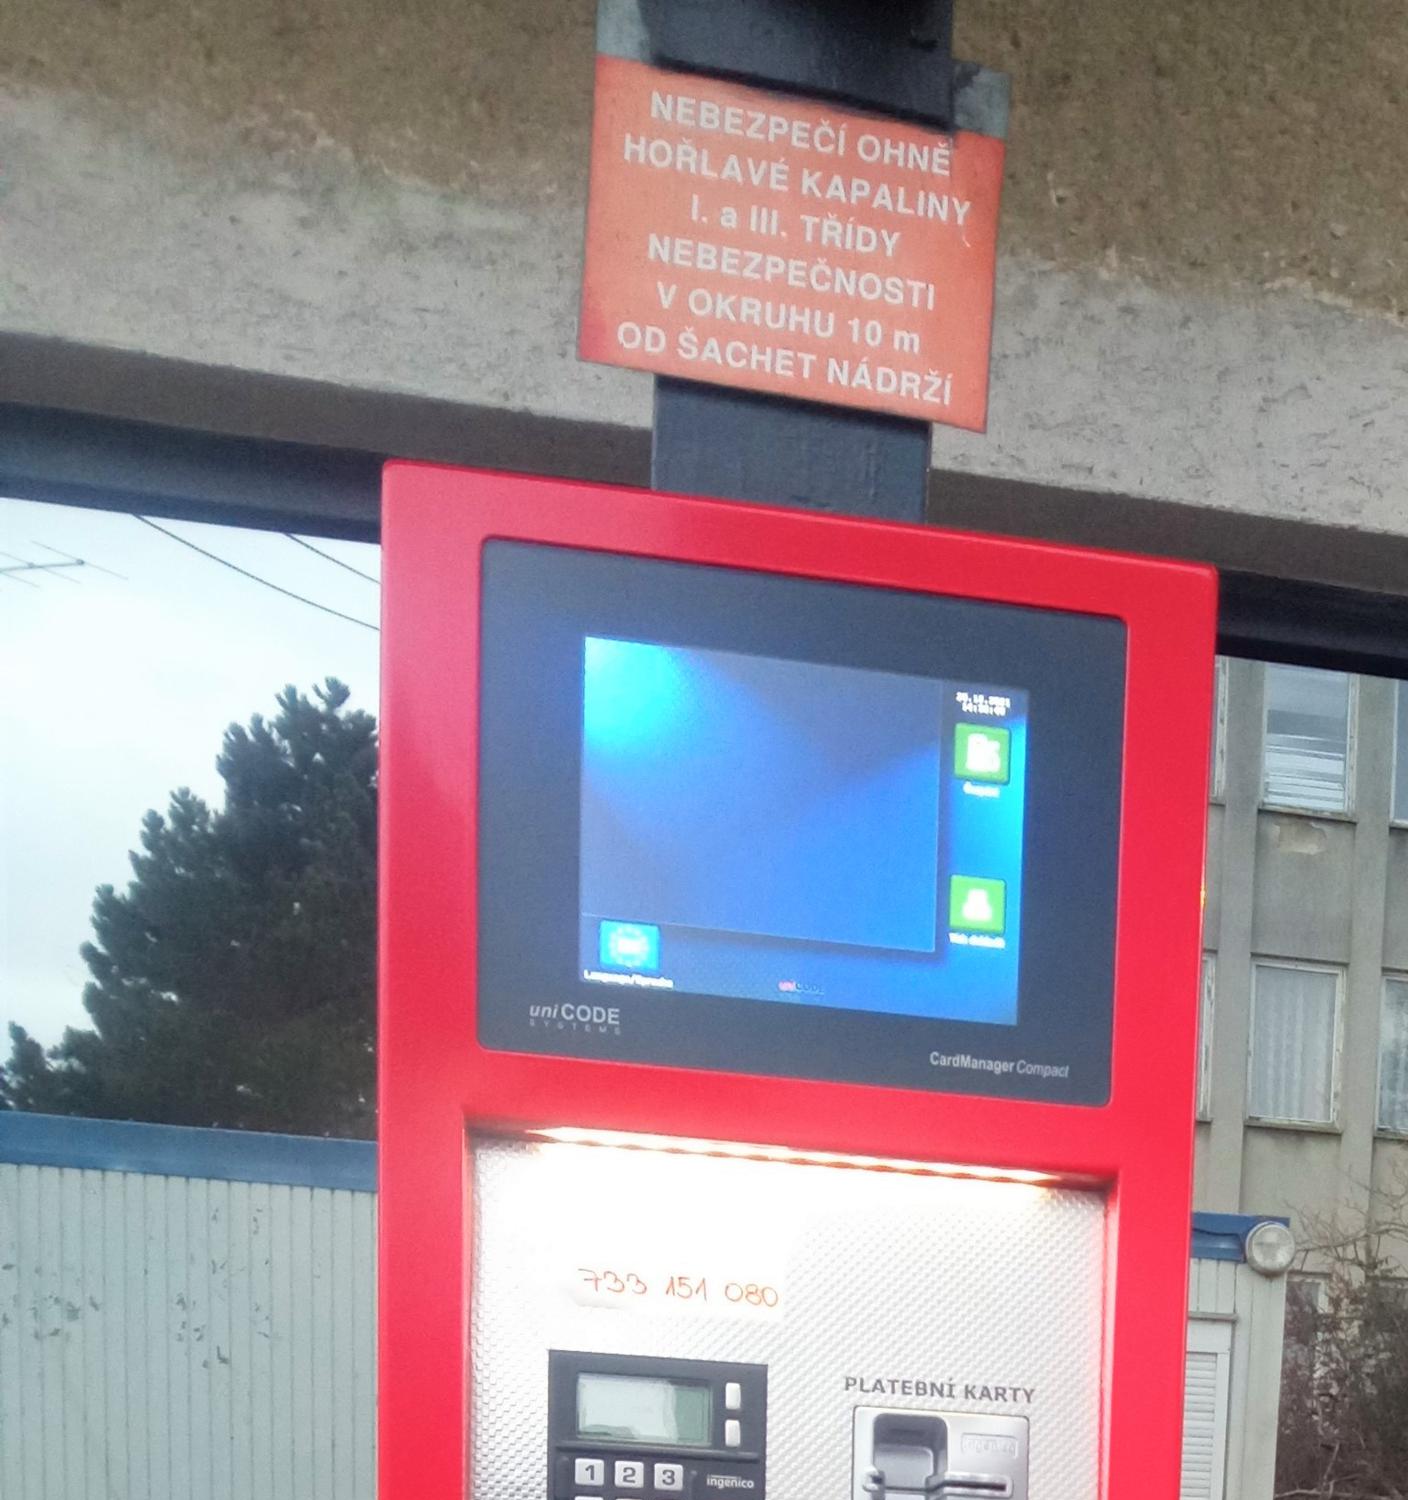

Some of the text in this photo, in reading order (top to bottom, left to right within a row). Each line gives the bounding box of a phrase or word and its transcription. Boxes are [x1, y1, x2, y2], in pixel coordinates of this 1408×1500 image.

[651, 91, 951, 176] NEBEZPEČÍ OHNĚ
[624, 133, 971, 227] HOŘLAVÉ KAPALINY
[691, 194, 899, 257] I. a III. TŘÍDY
[648, 233, 935, 311] NEBEZPEČNOSTI
[658, 282, 920, 354] V OKRUHU 10 m
[617, 322, 952, 406] OD ŠACHET NÁDRŽÍ
[530, 1002, 620, 1024] uniCODE
[930, 1052, 1070, 1078] CardManager Compact
[578, 1268, 778, 1307] 733 151 080
[844, 1376, 1035, 1404] PLATEBNÍ KARTY
[585, 1465, 675, 1485] 1 2 3
[707, 1475, 755, 1490] ingenico
